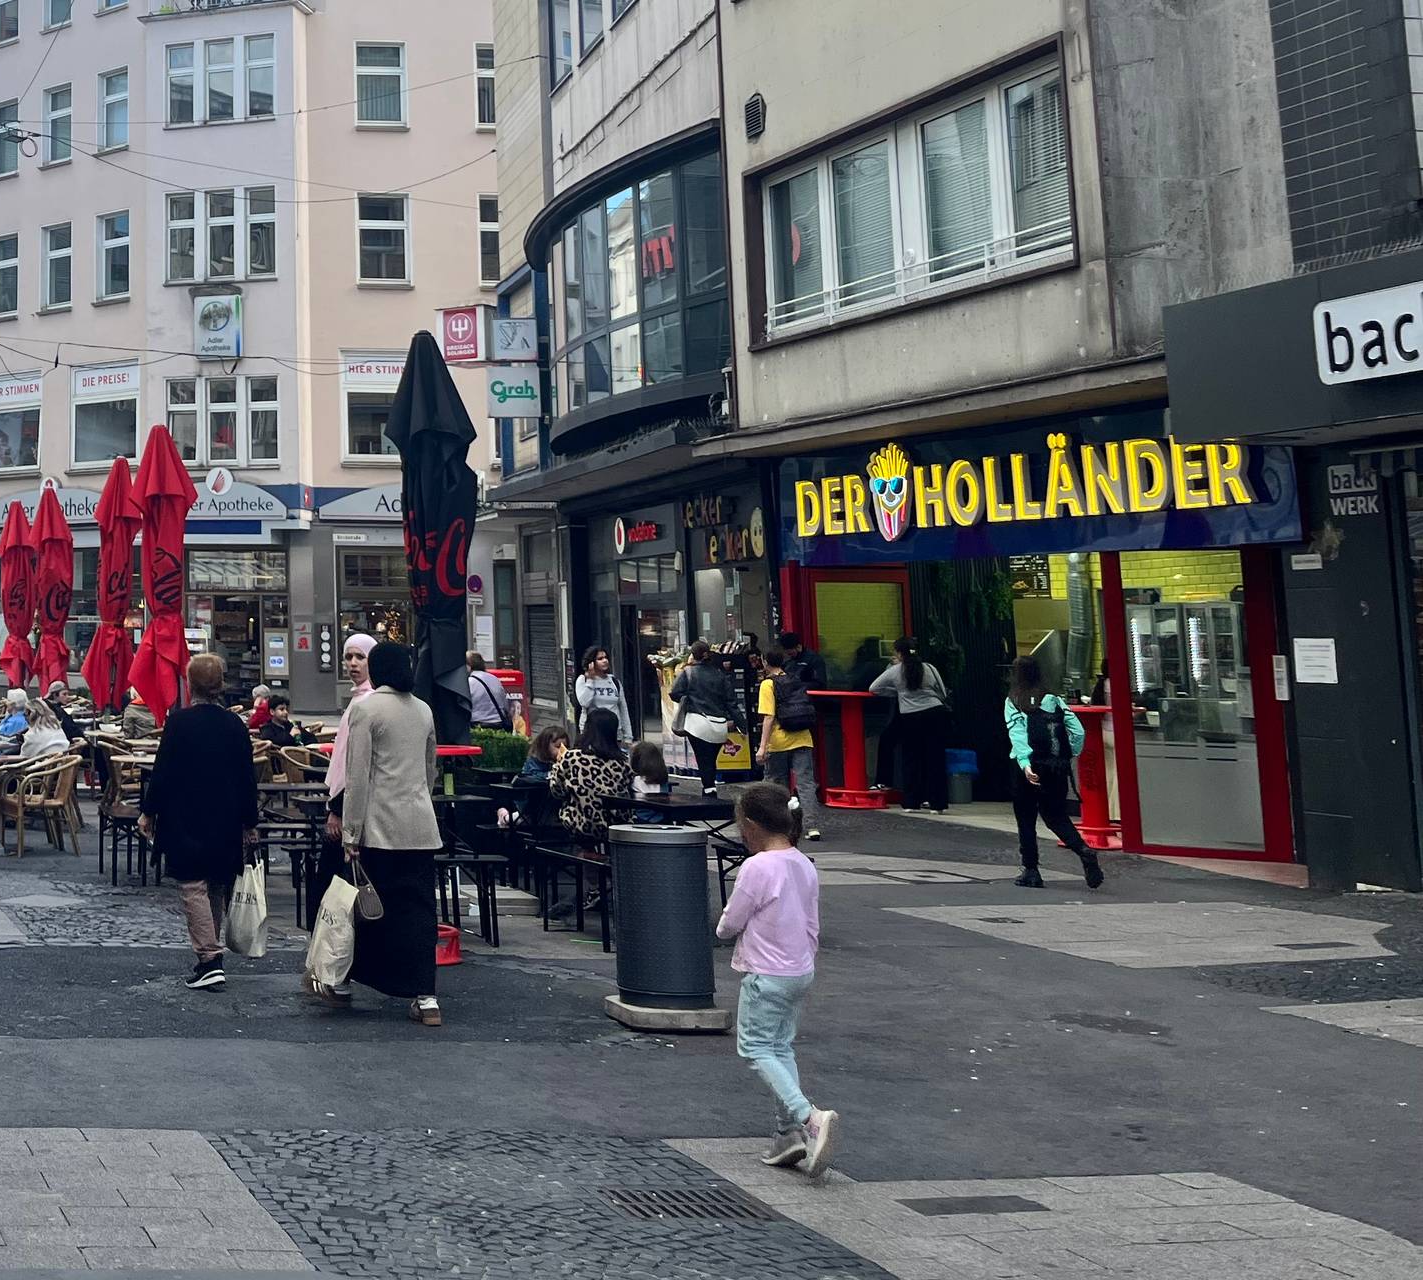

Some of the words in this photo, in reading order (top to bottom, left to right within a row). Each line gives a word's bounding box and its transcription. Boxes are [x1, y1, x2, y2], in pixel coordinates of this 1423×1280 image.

[1322, 290, 1423, 374] bac
[348, 364, 372, 374] HIER
[375, 364, 404, 374] STIM
[5, 383, 40, 397] STIMMEN
[82, 377, 96, 388] DIE
[97, 372, 130, 385] PREISE!
[490, 380, 538, 404] Grah
[794, 473, 874, 538] DER
[912, 432, 1253, 529] HOLLÄNDER
[1330, 469, 1375, 491] back
[208, 499, 275, 517] Apotheke
[1330, 495, 1379, 516] WERK
